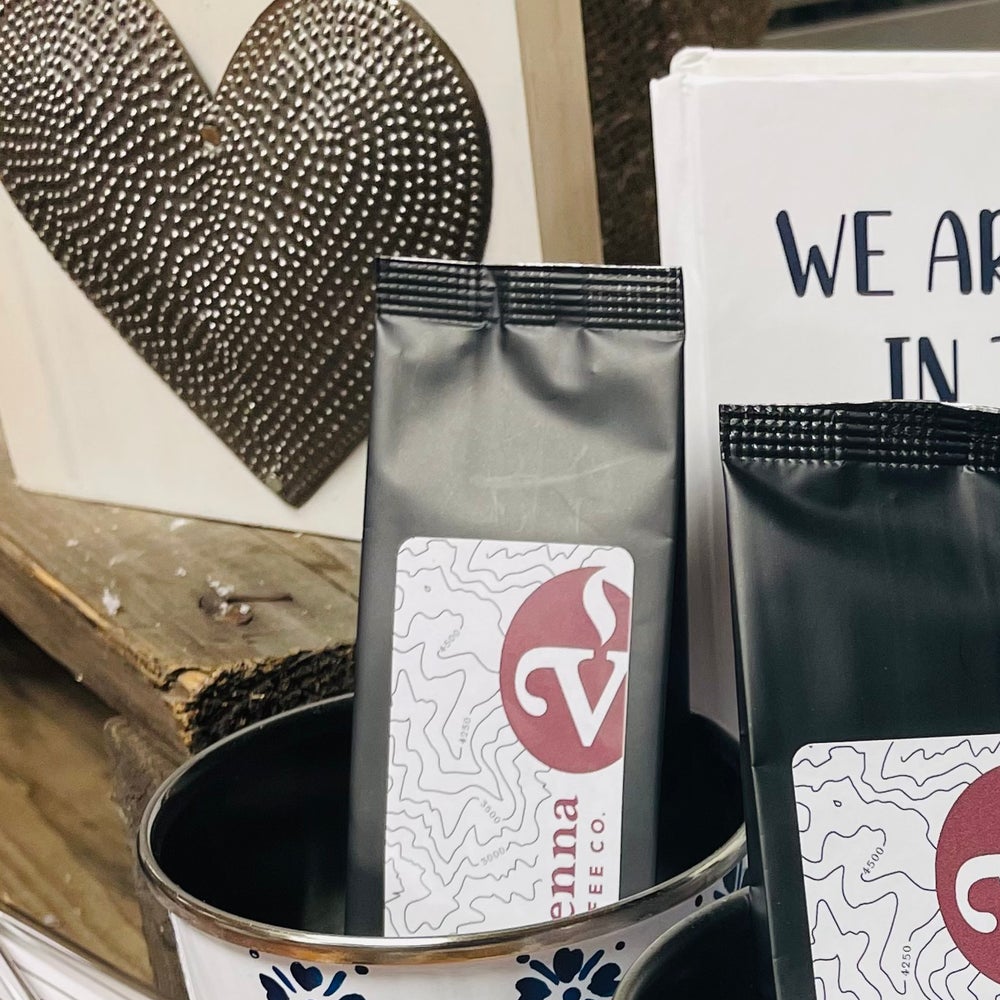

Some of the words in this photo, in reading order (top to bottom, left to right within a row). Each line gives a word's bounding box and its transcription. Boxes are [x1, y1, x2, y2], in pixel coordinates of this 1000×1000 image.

[776, 209, 894, 298] WE
[884, 336, 959, 403] IN
[550, 795, 579, 920] enna
[862, 846, 885, 875] 4500
[900, 945, 912, 976] 4250
